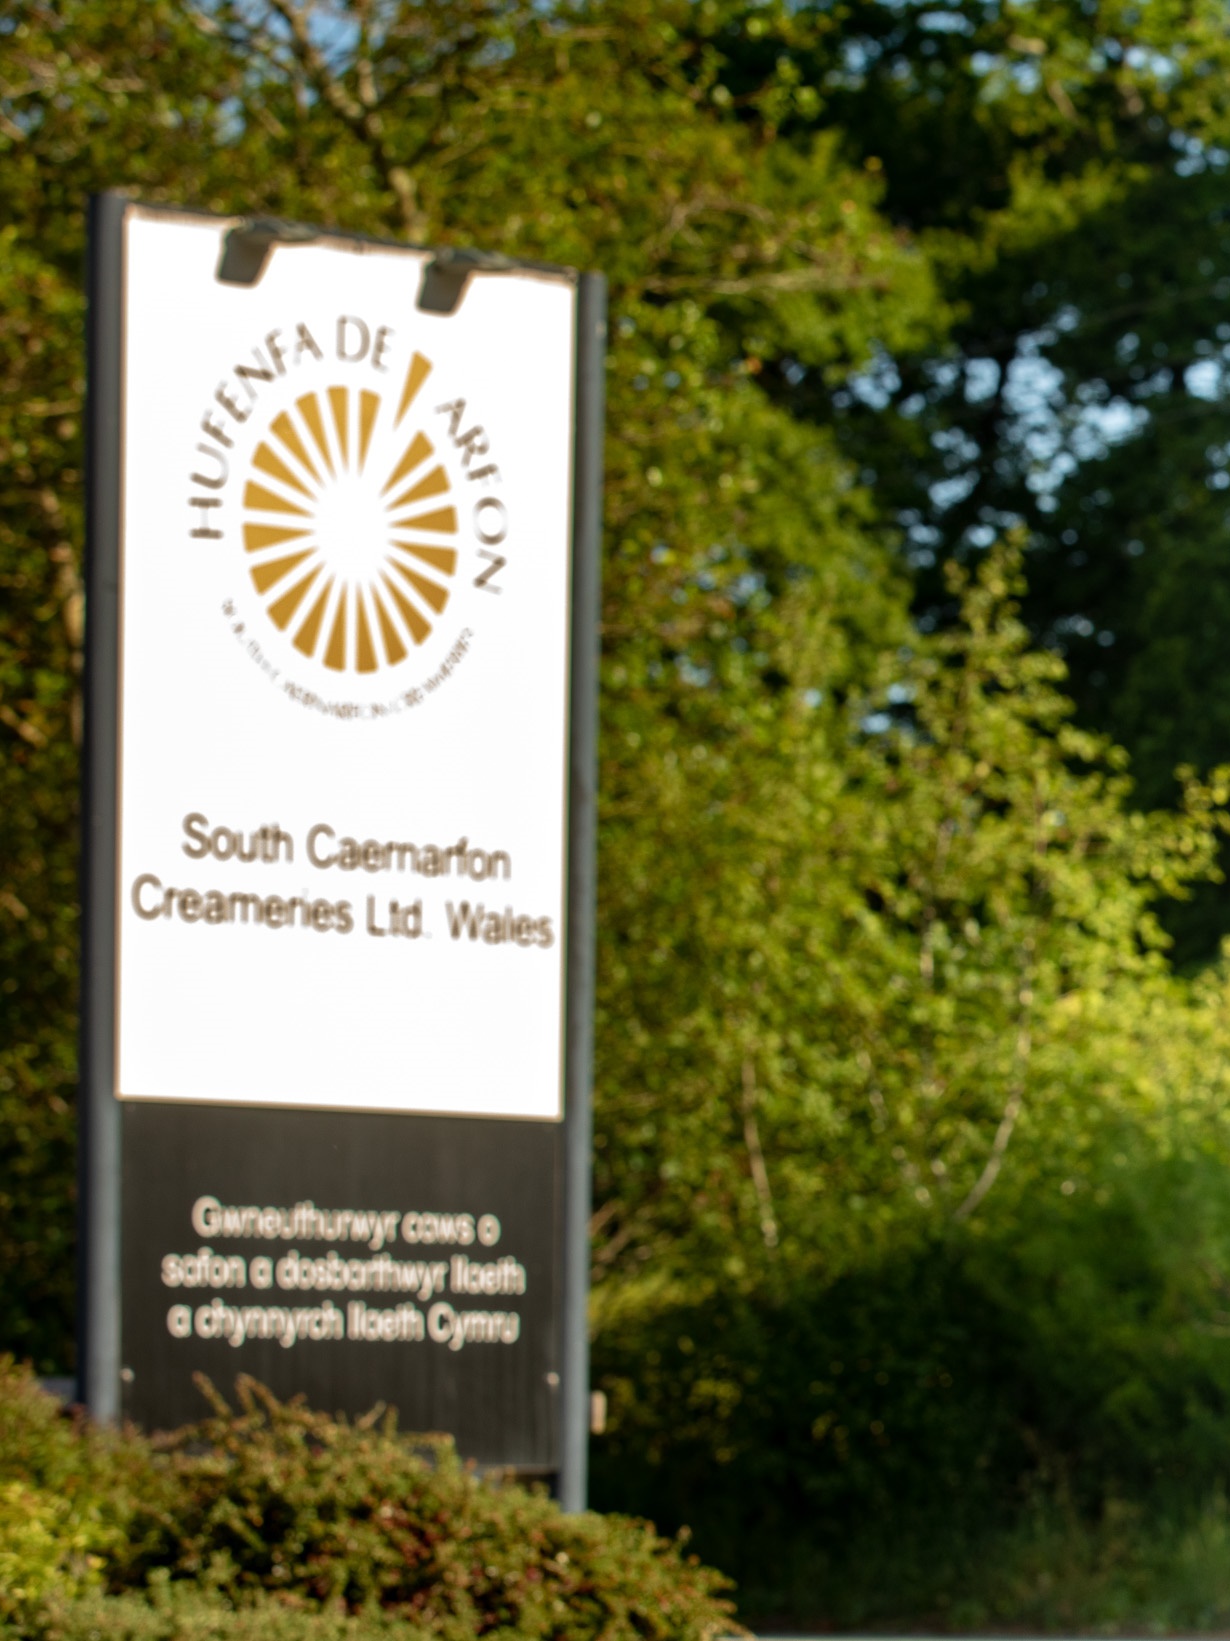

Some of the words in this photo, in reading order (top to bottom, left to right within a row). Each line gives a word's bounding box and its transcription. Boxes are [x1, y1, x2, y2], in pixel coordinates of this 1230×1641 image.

[189, 322, 324, 540] HUFENFA
[336, 315, 395, 373] DE
[435, 397, 509, 595] ARFON
[182, 811, 294, 864] South
[306, 823, 511, 881] Caernarfon
[131, 873, 354, 934] Creameries
[446, 899, 555, 949] Wales
[426, 1301, 521, 1352] Cymru
